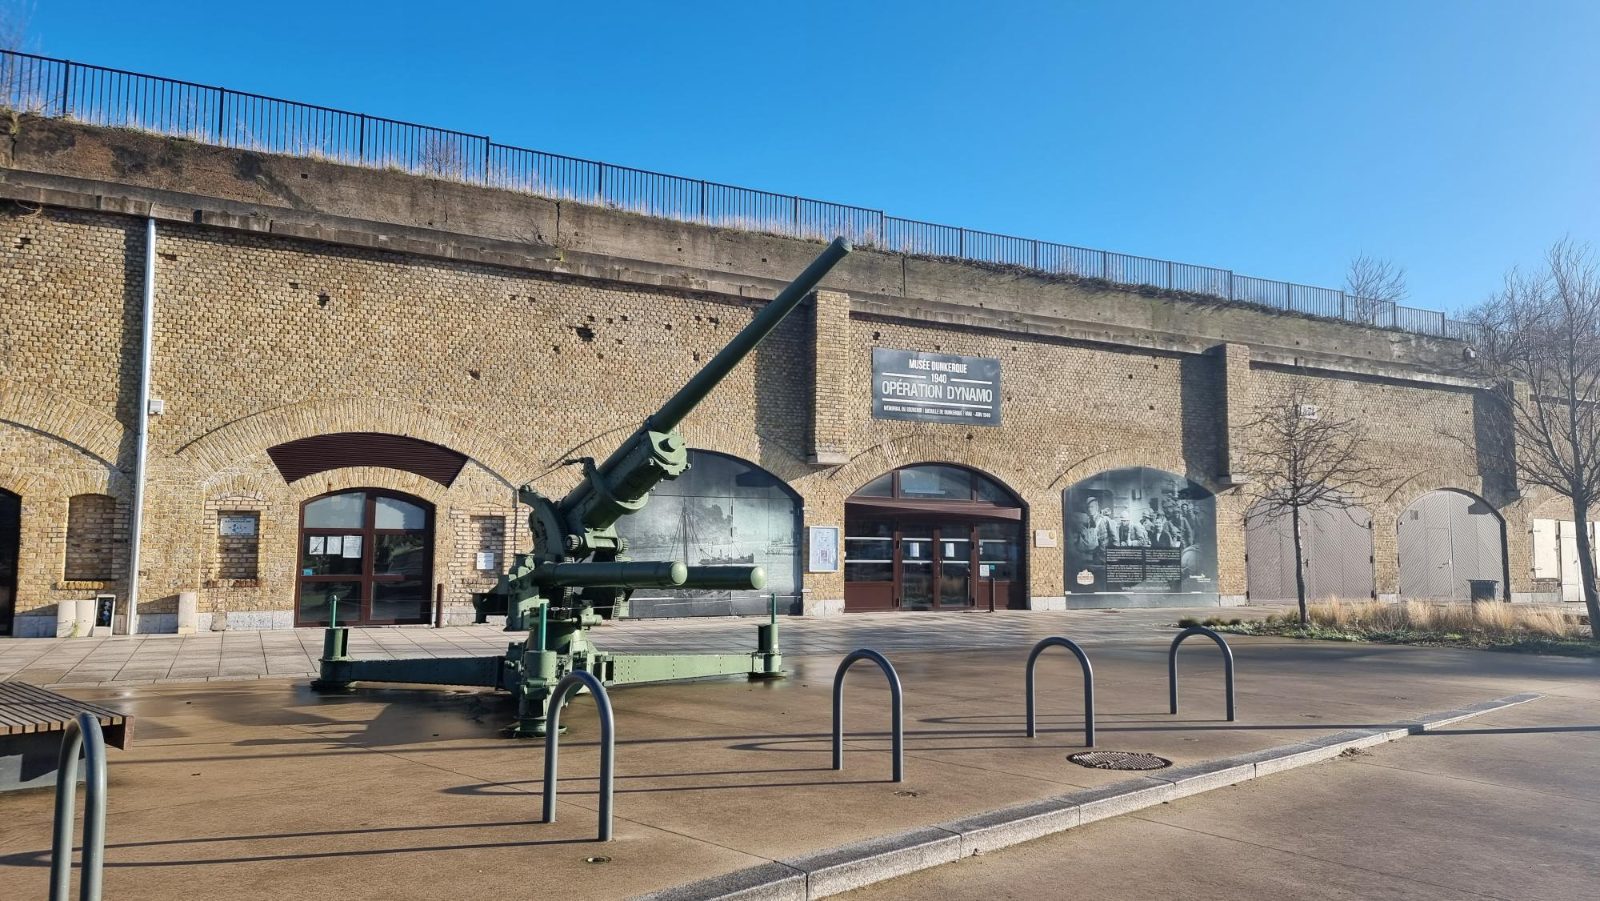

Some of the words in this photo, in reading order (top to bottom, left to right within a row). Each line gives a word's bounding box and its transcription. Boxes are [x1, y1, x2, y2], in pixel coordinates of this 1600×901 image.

[909, 359, 930, 370] MUSÉE
[931, 361, 967, 374] DUNKERQUE
[931, 373, 947, 383] 1940
[882, 379, 942, 399] OPÉRATION
[947, 386, 992, 402] DYNAMO
